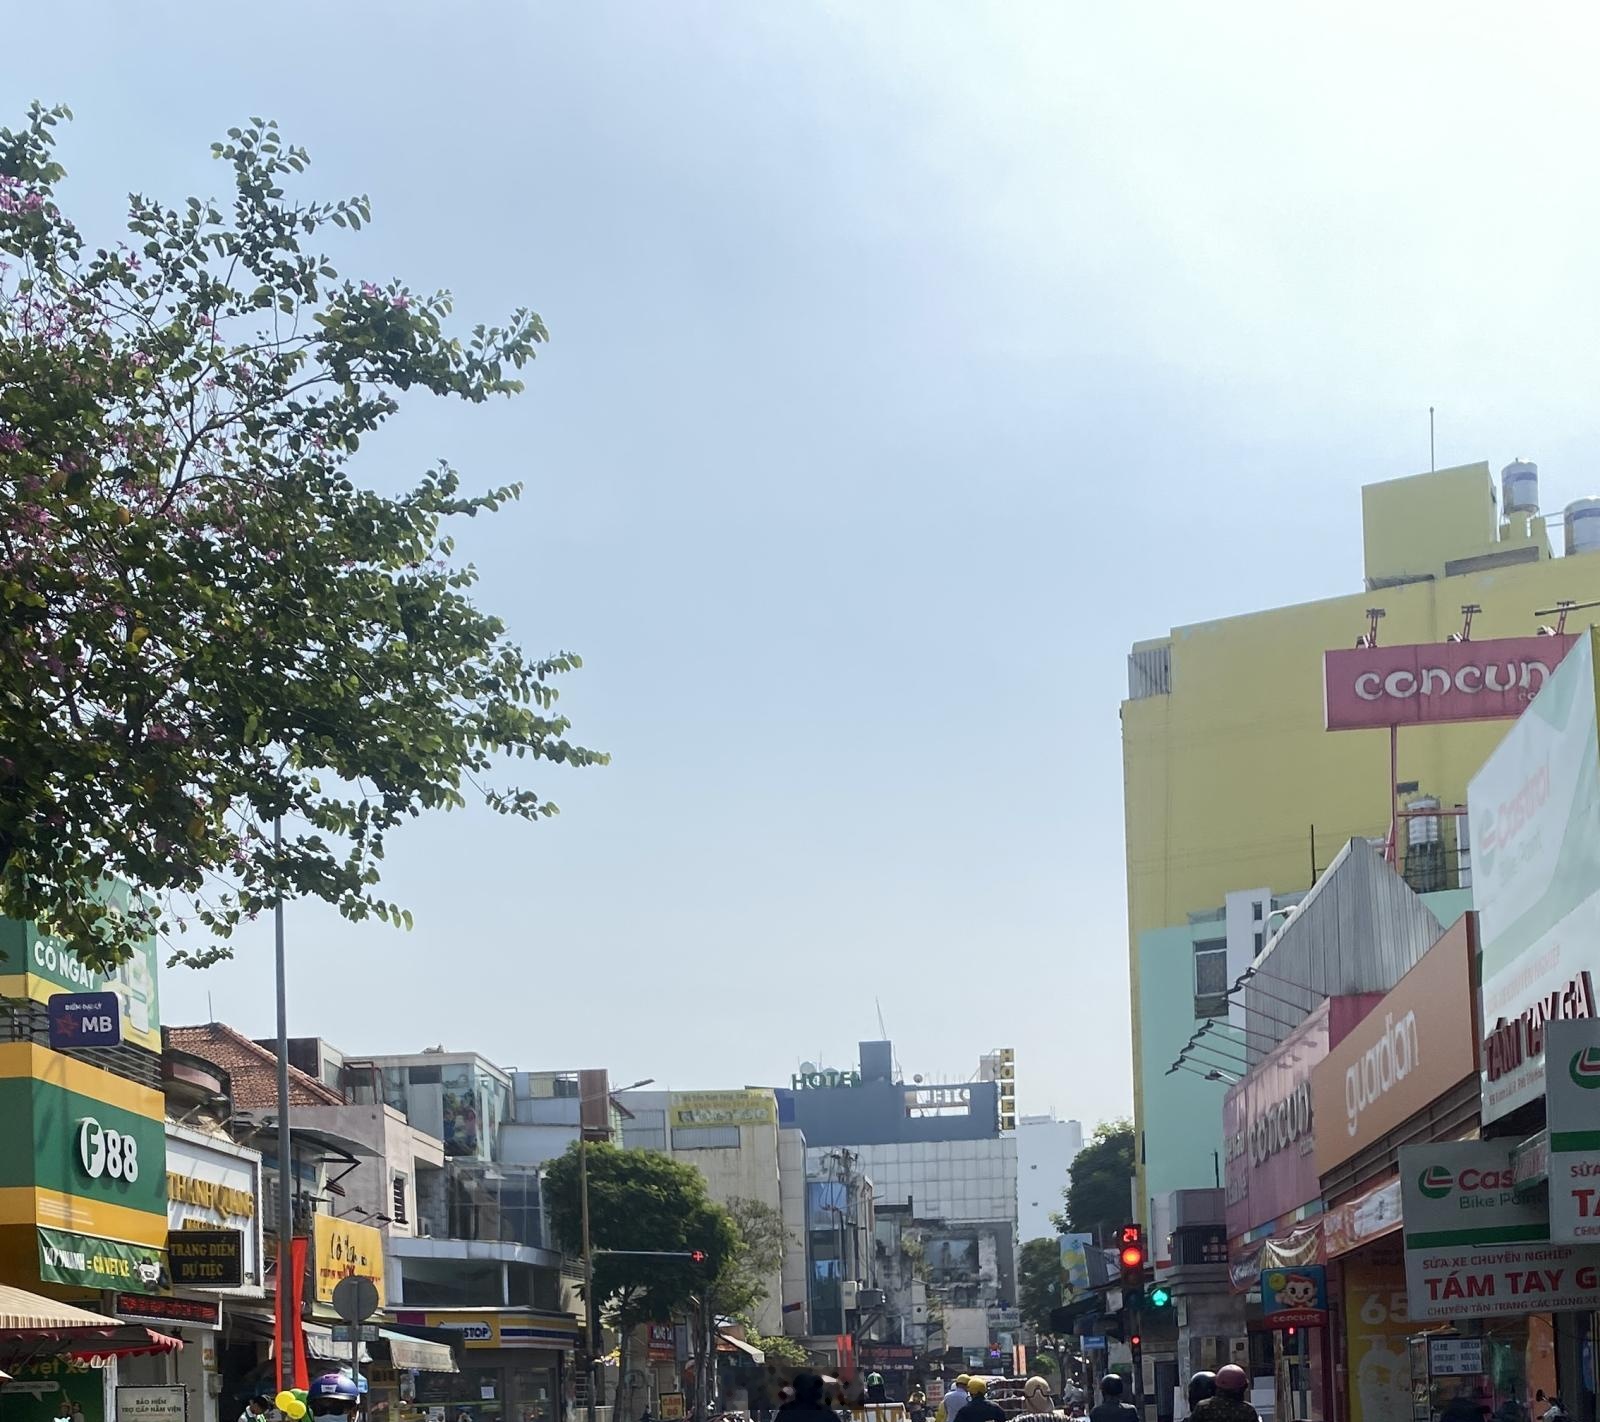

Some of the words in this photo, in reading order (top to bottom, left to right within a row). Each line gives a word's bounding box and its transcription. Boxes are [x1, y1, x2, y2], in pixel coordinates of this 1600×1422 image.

[1355, 660, 1553, 701] concun
[34, 940, 56, 971] CÓ
[82, 1016, 112, 1033] MB
[1346, 1010, 1419, 1136] guardian
[80, 1117, 138, 1183] F88
[1460, 1194, 1494, 1209] Bike
[1123, 1228, 1138, 1242] 24
[171, 1244, 206, 1257] TRANG
[1423, 1252, 1449, 1270] SỬA
[1452, 1256, 1467, 1267] XE
[1470, 1250, 1521, 1266] CHUYÊN
[1424, 1270, 1495, 1301] TÁM
[1504, 1269, 1565, 1294] TAY
[1575, 1266, 1600, 1290] G
[1427, 1302, 1469, 1316] CHUYÊN
[1494, 1299, 1529, 1311] TRANG
